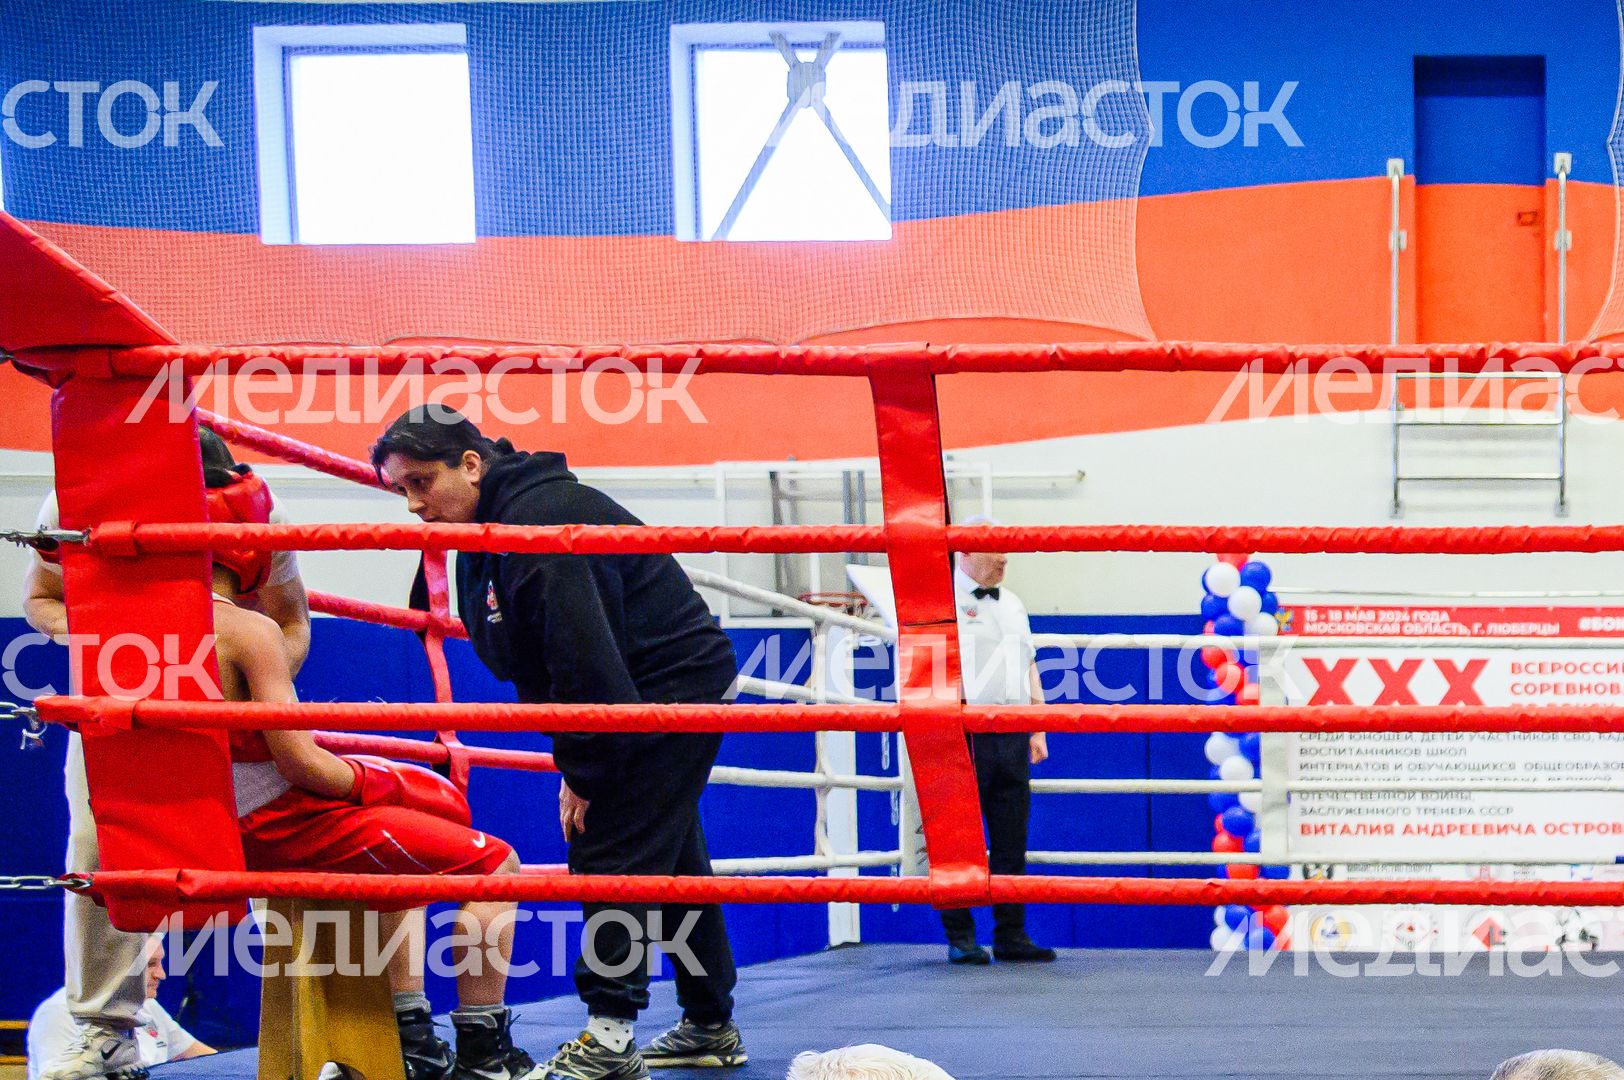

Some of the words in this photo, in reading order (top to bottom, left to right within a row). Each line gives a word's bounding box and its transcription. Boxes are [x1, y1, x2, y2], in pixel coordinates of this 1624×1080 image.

[1345, 609, 1375, 622] МАЯ
[1412, 610, 1450, 623] ГОДА
[1304, 622, 1400, 635] МОСКОВСКАЯ
[1487, 622, 1560, 636] ЛЮБЕРЦЫ
[1299, 823, 1395, 837] ВИТАЛИЯ
[1402, 823, 1536, 836] АНДРЕЕВИЧА
